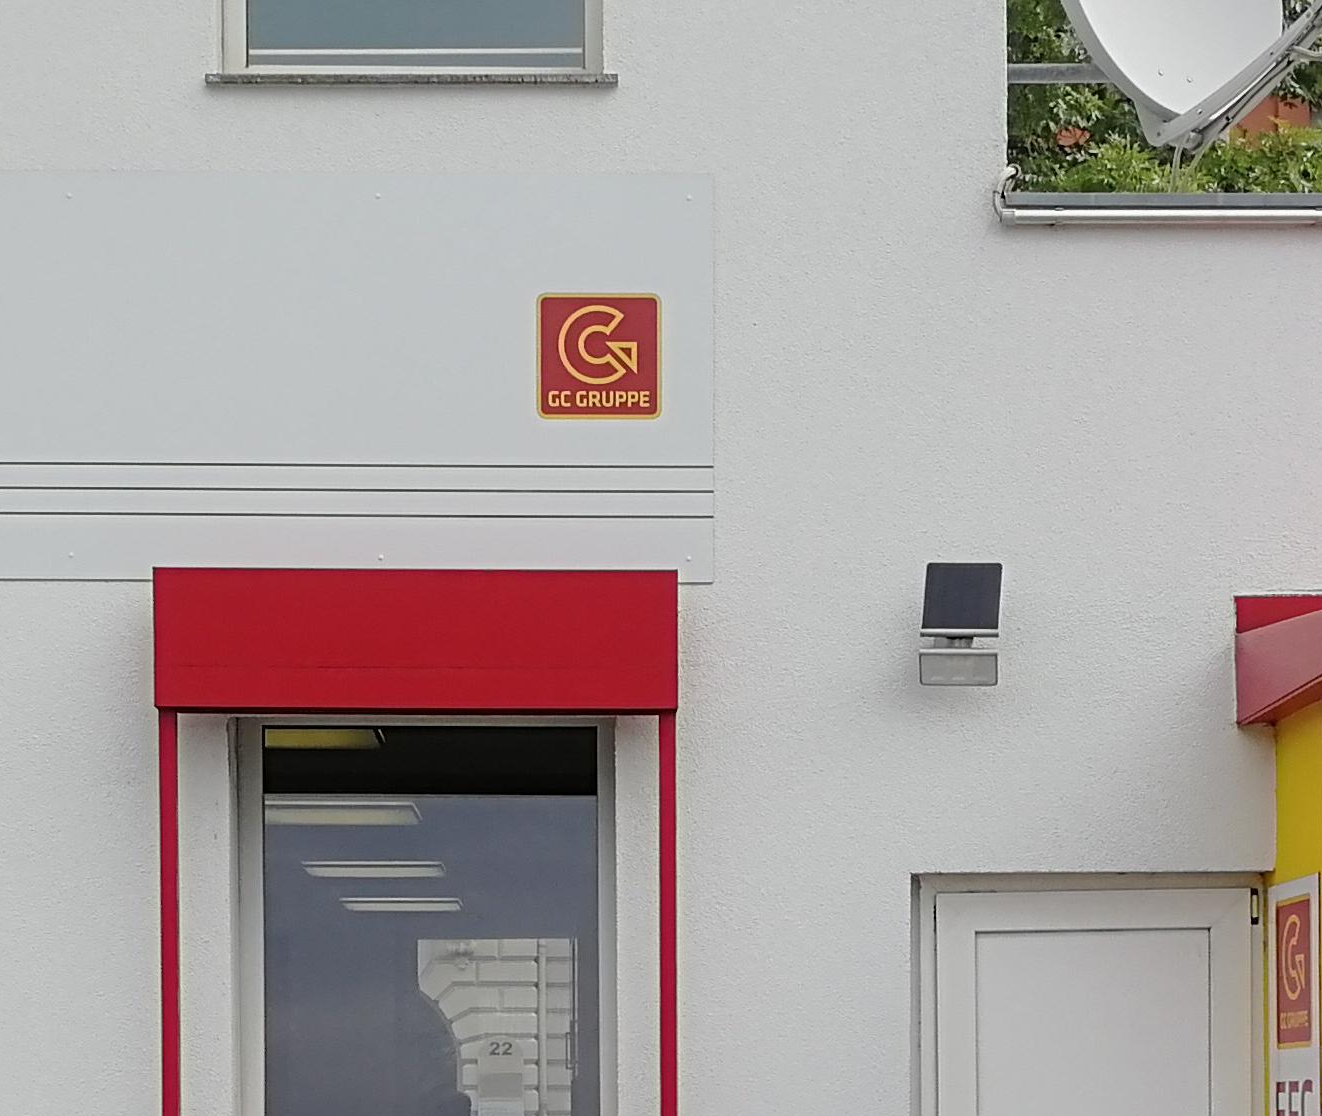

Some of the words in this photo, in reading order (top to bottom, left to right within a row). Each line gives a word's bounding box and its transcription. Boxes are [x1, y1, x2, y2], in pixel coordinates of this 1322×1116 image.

[547, 390, 572, 408] GC
[575, 390, 651, 408] GRUPPE
[1288, 1009, 1310, 1030] GRUPPE
[489, 1042, 513, 1056] 22
